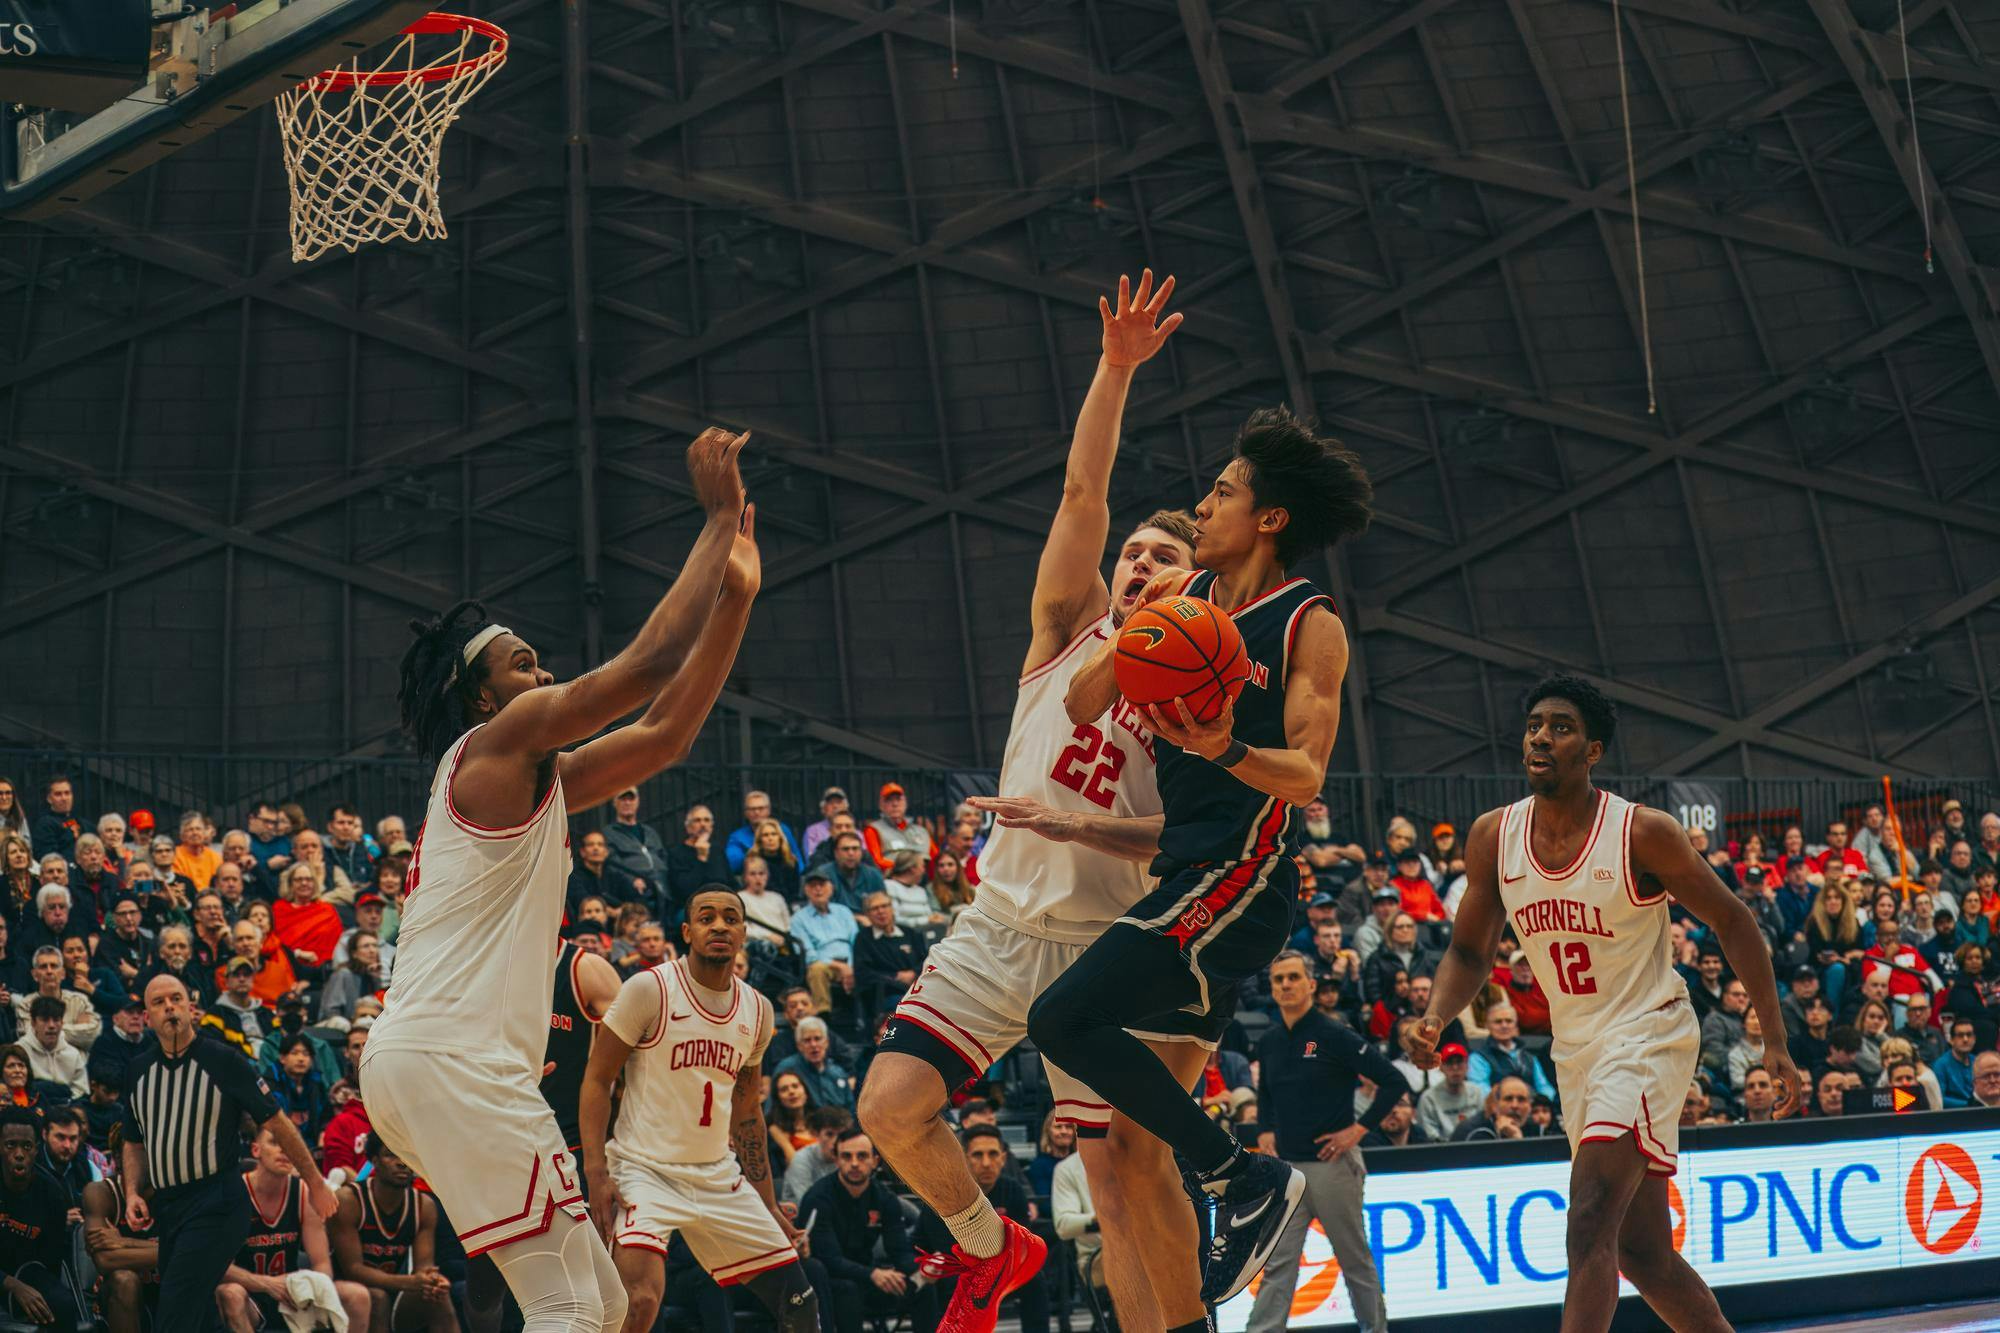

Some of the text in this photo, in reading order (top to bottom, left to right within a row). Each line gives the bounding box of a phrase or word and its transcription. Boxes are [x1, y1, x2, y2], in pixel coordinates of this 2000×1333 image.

[1050, 723, 1126, 810] 22
[1679, 803, 1717, 831] 108
[1514, 898, 1615, 938] CORNELL
[1548, 941, 1598, 996] 12
[699, 1080, 713, 1127] 1
[552, 1153, 575, 1192] C
[624, 1203, 637, 1229] C
[1699, 1162, 1883, 1263] PNC
[1362, 1189, 1569, 1294] PNC
[254, 1250, 286, 1277] 14
